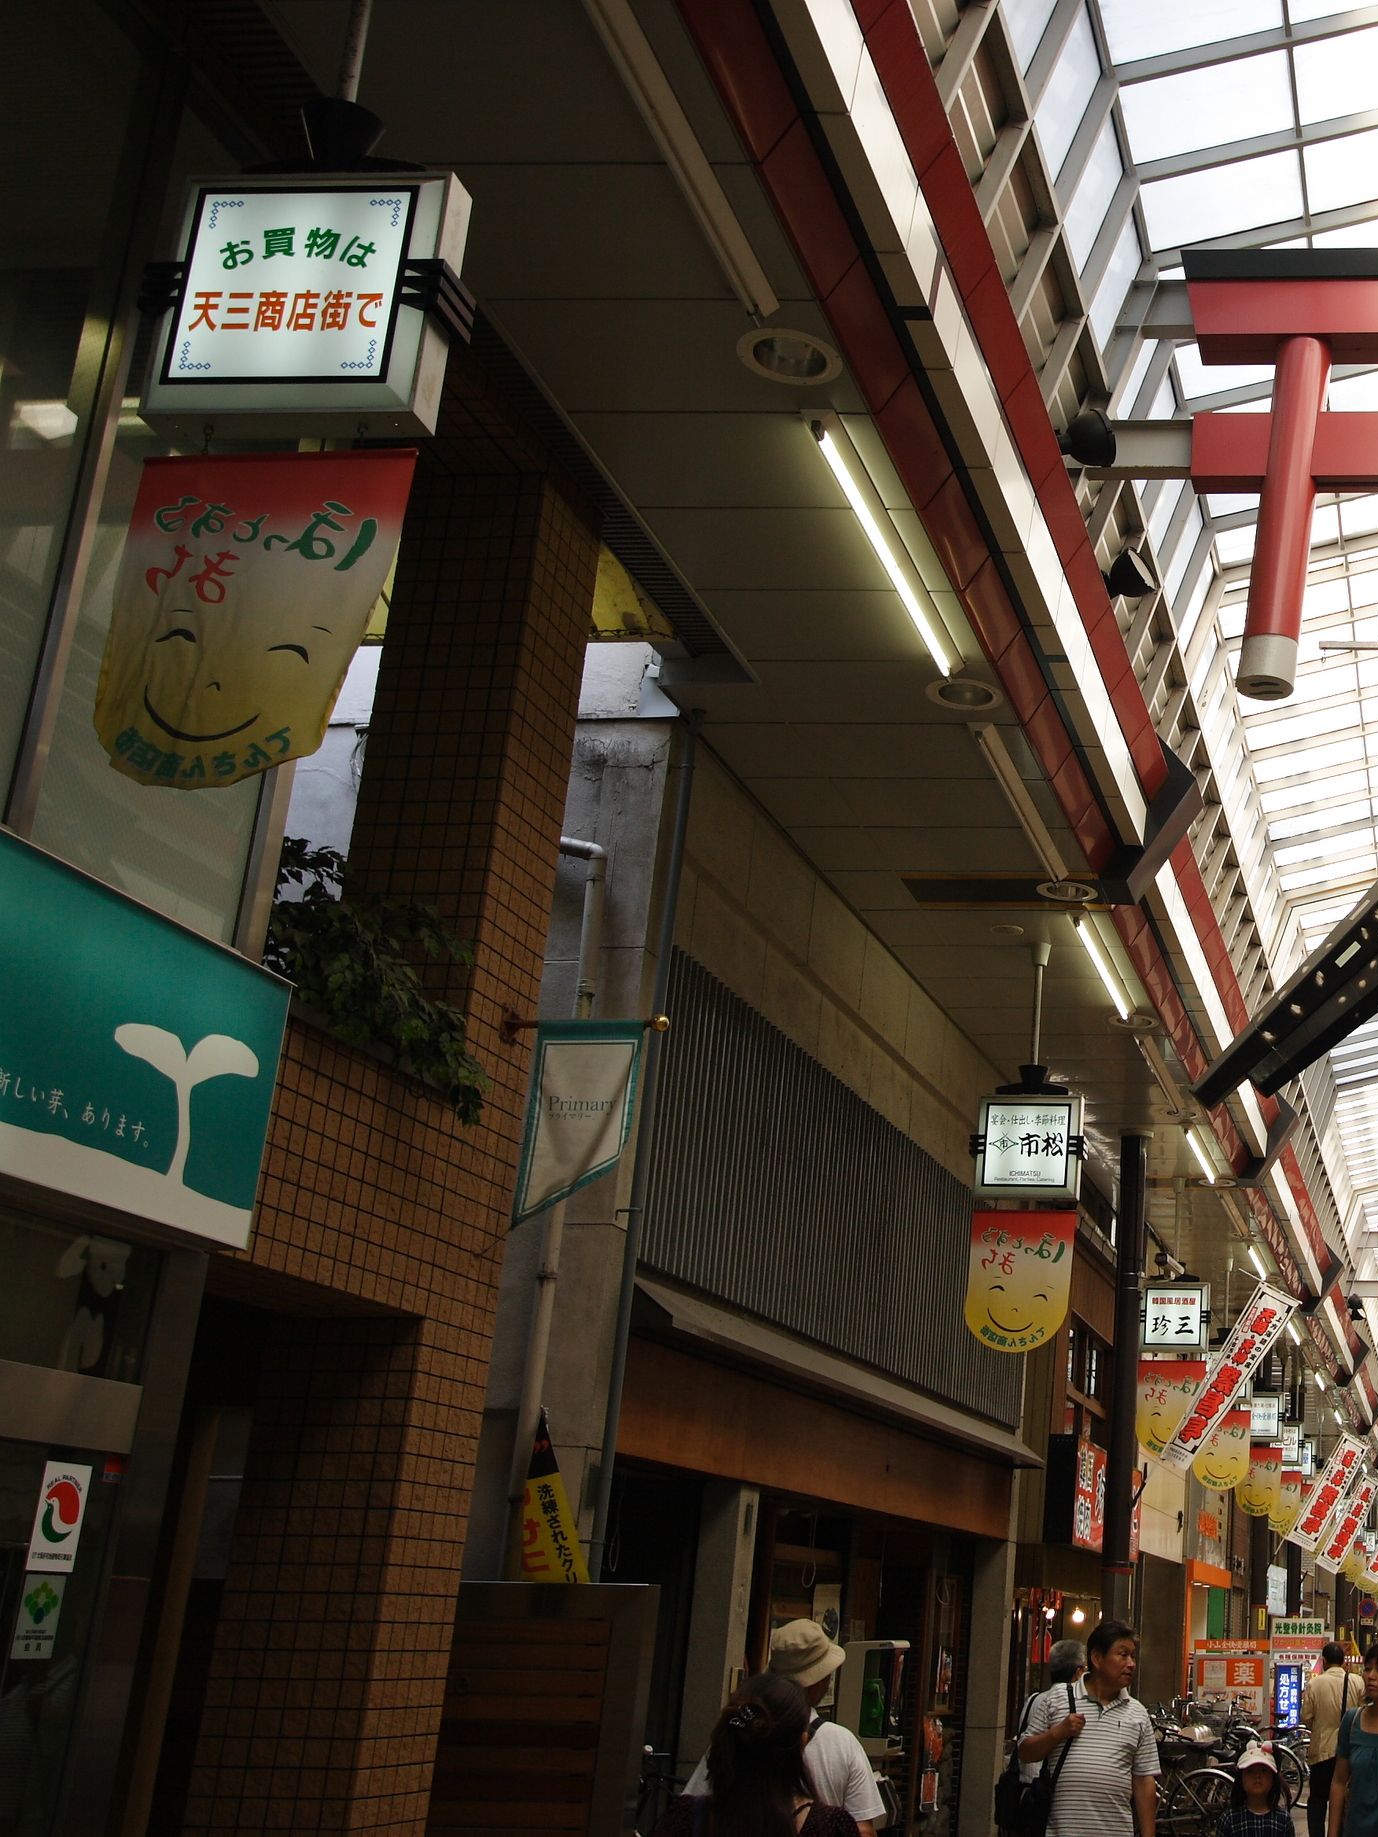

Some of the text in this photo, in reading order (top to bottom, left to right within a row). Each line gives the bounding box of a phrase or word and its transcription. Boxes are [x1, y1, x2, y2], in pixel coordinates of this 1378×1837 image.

[219, 226, 377, 270] お買物は
[188, 289, 384, 332] 天三商店街で
[1018, 1131, 1064, 1158] 市松
[1234, 1662, 1256, 1685] 薬
